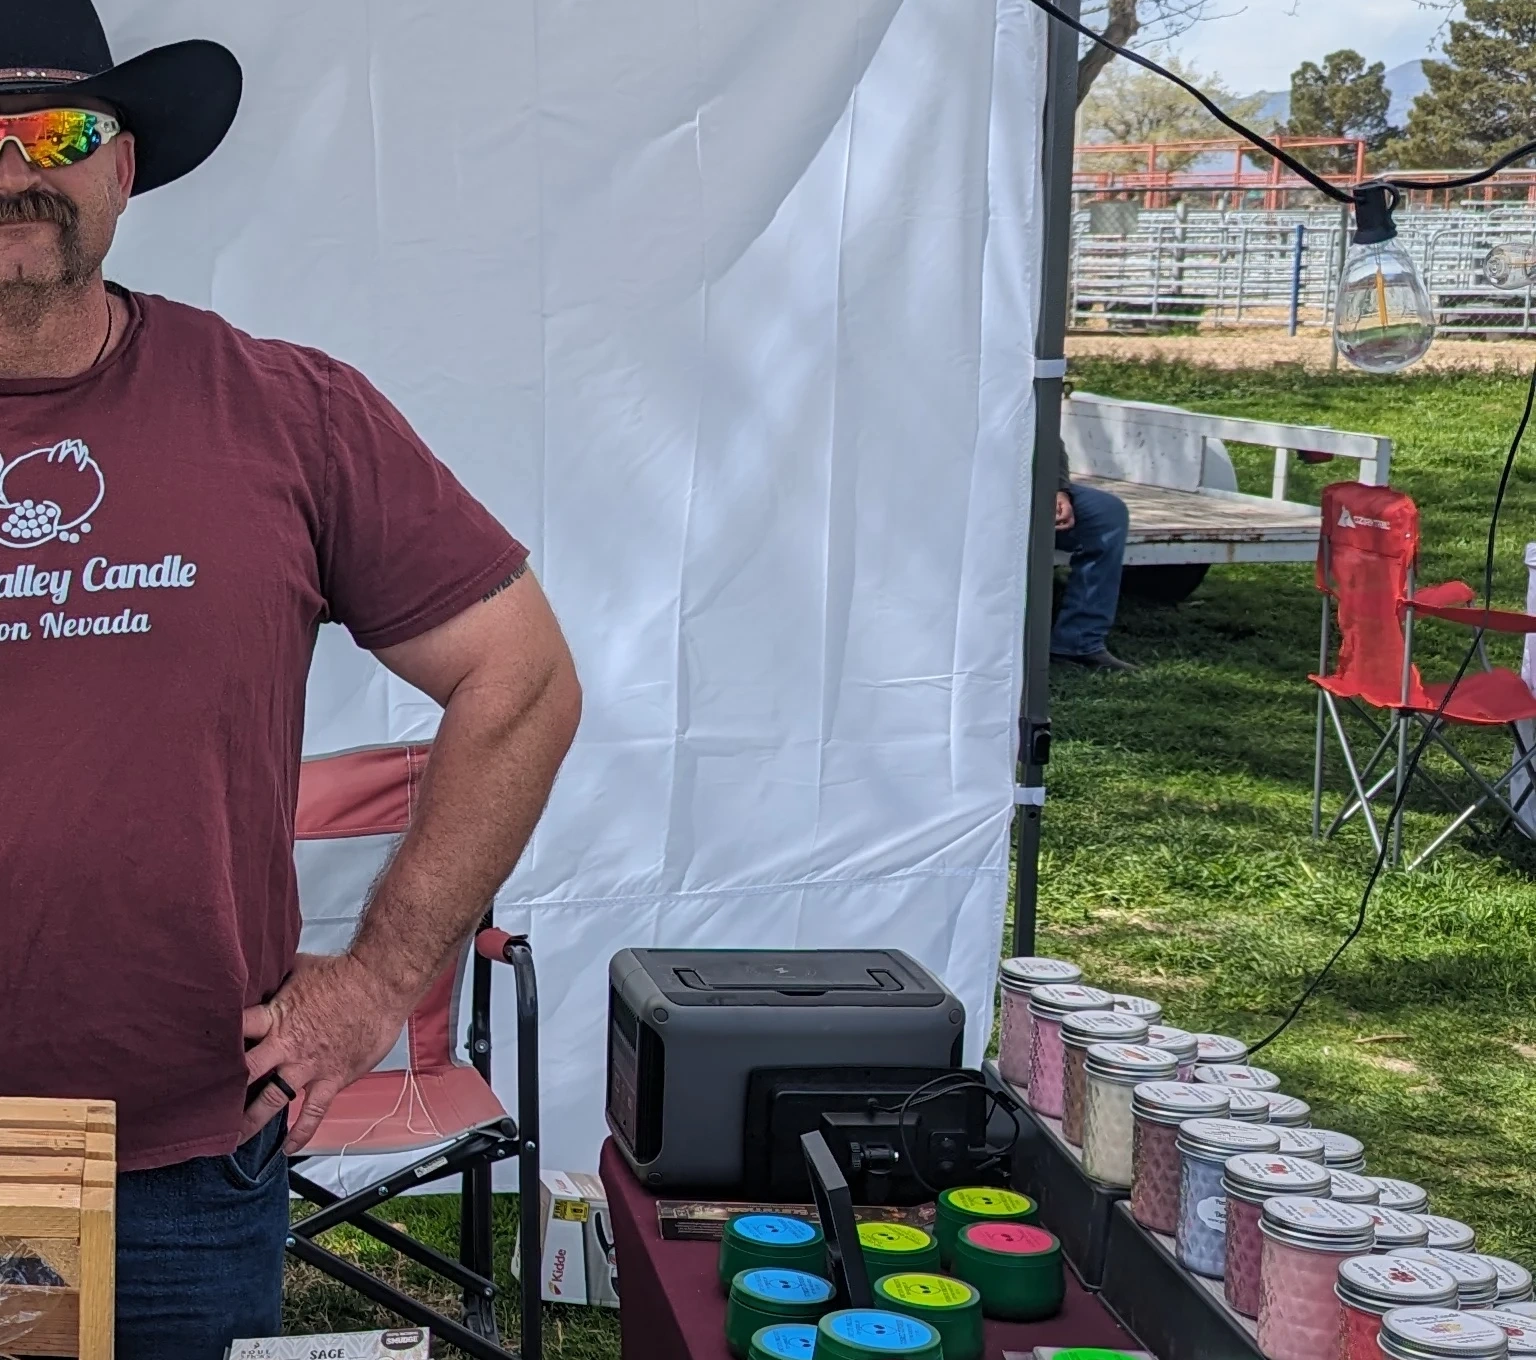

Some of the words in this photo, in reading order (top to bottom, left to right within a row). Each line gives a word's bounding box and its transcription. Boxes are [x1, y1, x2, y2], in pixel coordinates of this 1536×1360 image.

[82, 555, 197, 591] Candle
[39, 609, 152, 639] Nevada
[552, 1249, 566, 1282] Kidde
[310, 1349, 345, 1360] SAGE
[386, 1335, 419, 1345] SMUDGE
